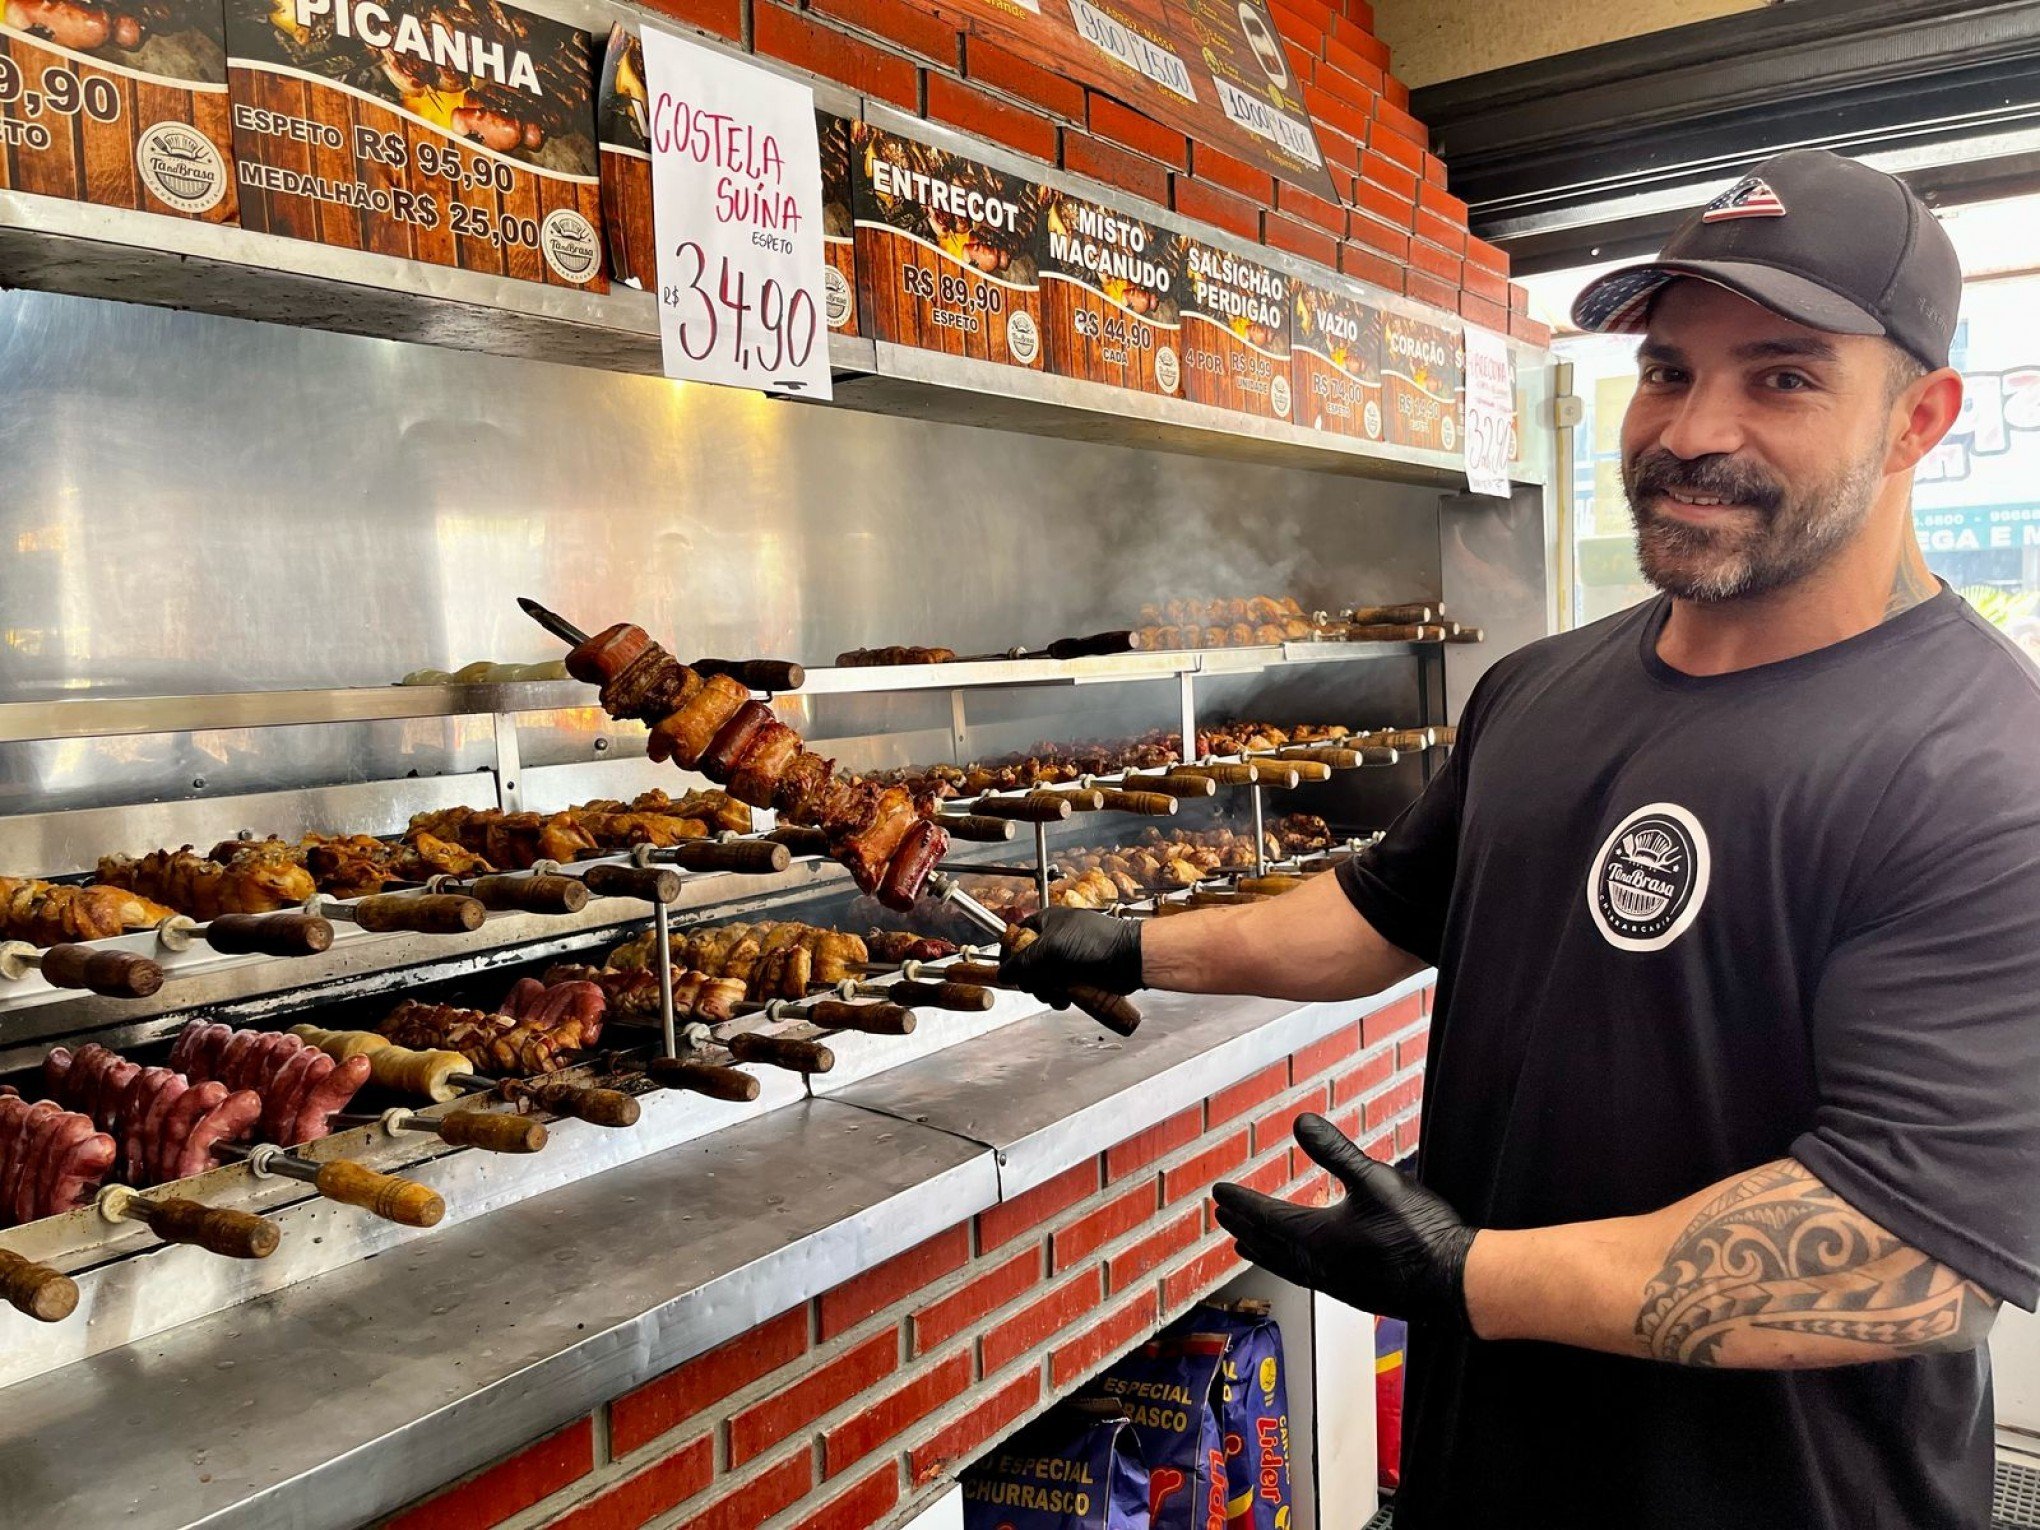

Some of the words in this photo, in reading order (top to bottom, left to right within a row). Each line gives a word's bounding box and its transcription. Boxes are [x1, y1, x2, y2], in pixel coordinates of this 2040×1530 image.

[297, 0, 543, 97] PICANHA
[0, 118, 51, 150] TO
[235, 104, 343, 149] ESPETO
[355, 125, 407, 168] R$
[417, 143, 514, 193] 95,90
[654, 92, 786, 186] COSTELA
[239, 161, 390, 213] MEDALHÃO
[391, 186, 440, 231] R$
[449, 202, 540, 249] 25,00
[715, 176, 803, 234] SUÍNA
[872, 158, 1020, 233] ENTRECOT
[751, 231, 794, 255] ESPETO
[1079, 207, 1145, 253] MISTO
[1050, 231, 1170, 293] MACANUDO
[1189, 246, 1284, 303] SALSICHÃO
[663, 285, 680, 308] R$
[675, 241, 817, 372] 34,90
[902, 264, 935, 302] R$
[941, 275, 1002, 315] 89,90
[1196, 280, 1282, 330] PERDIGÃO
[932, 309, 980, 333] ESPETO
[1104, 317, 1151, 351] 44,90
[1316, 308, 1359, 343] VAZIO
[1102, 348, 1129, 367] CADA
[1186, 347, 1196, 370] 4
[1197, 351, 1225, 375] POR
[1231, 352, 1248, 375] R$
[1390, 332, 1445, 368] CORAÇÃO
[1236, 375, 1272, 395] UNIDADE
[1312, 373, 1329, 397] R$
[1990, 525, 2012, 547] E
[1103, 1376, 1193, 1405] ESPECIAL
[1000, 1455, 1094, 1484] ESPECIAL
[964, 1478, 1091, 1517] CHURRASCO
